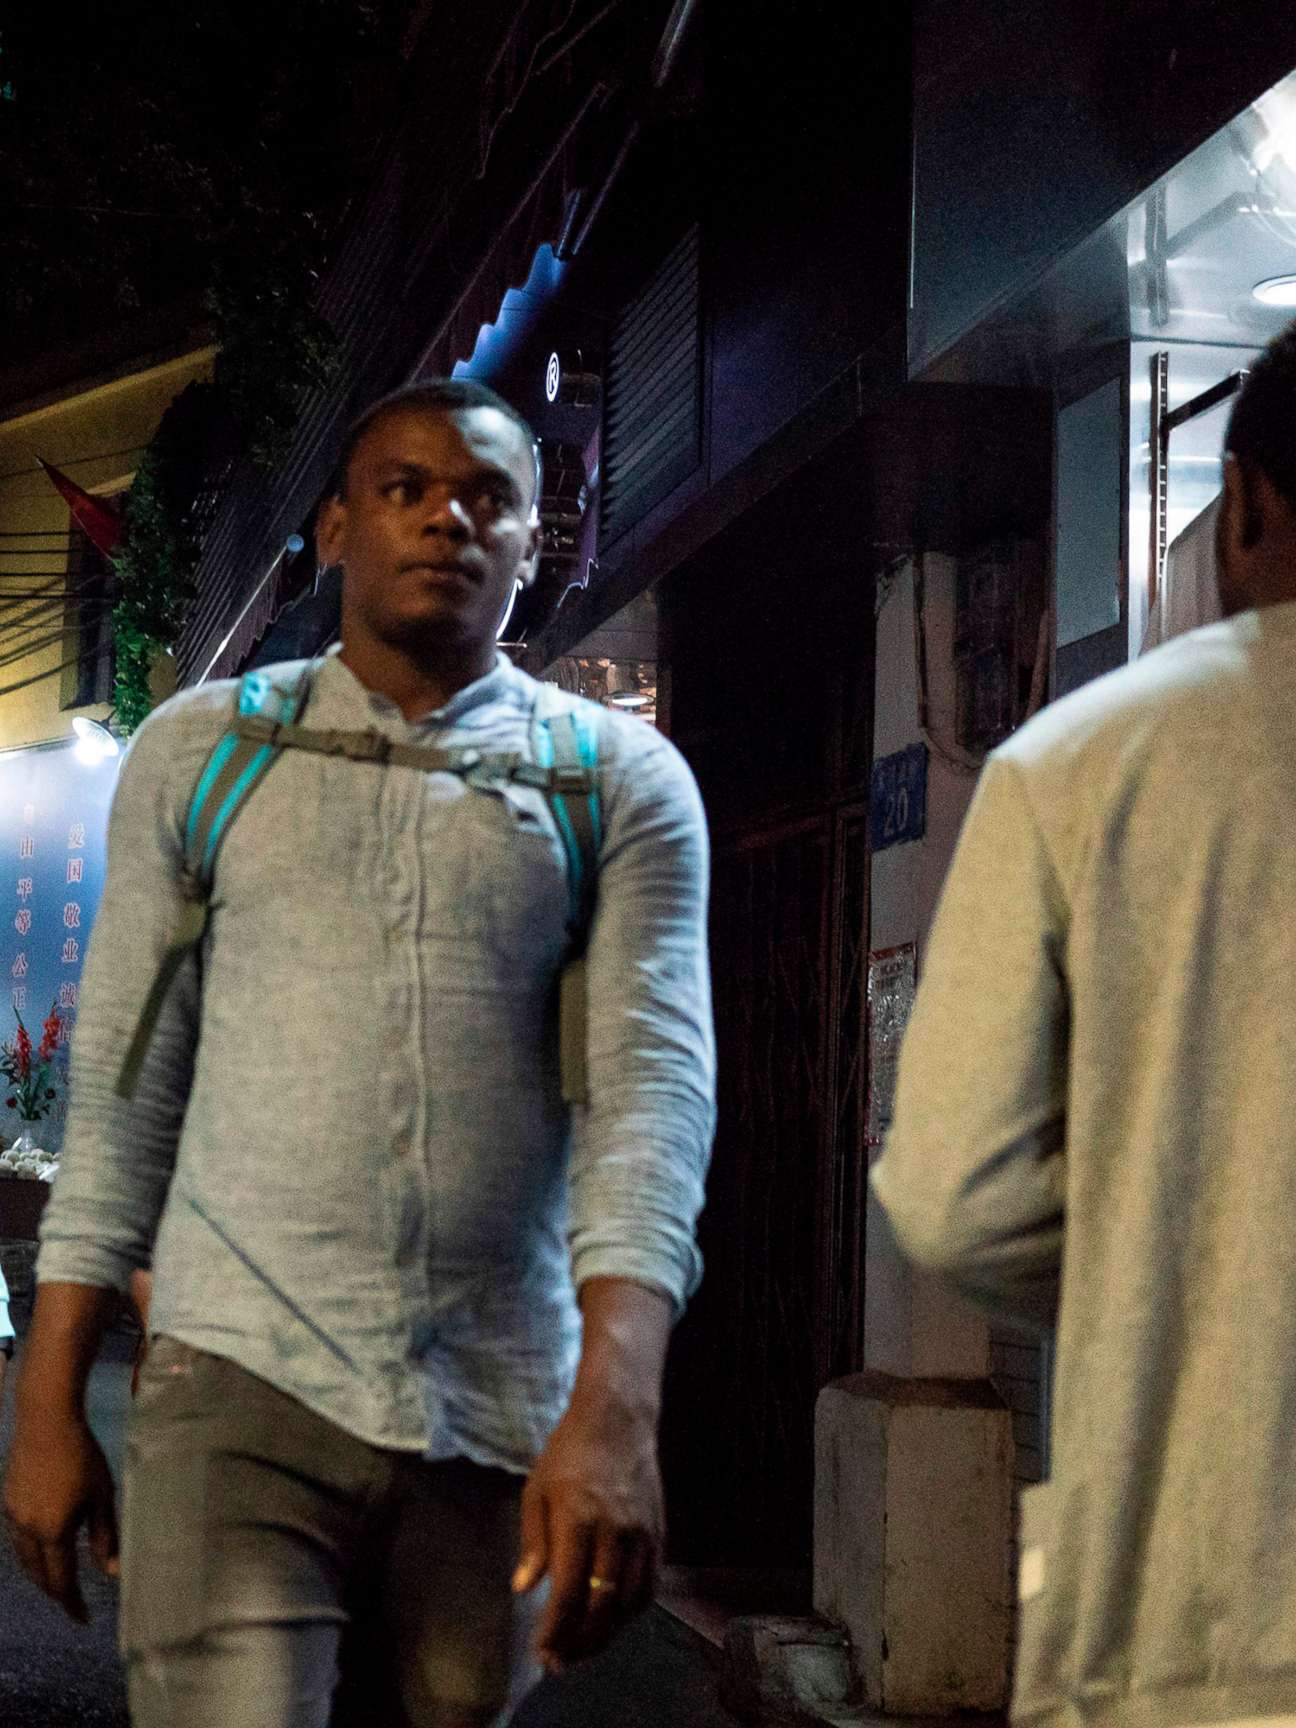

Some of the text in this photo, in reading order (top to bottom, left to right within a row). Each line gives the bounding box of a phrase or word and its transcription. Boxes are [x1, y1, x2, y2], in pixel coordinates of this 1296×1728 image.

[66, 822, 85, 884] 爱国
[15, 877, 32, 935] 平等
[61, 901, 81, 963] 敬业
[11, 952, 28, 1010] 公正
